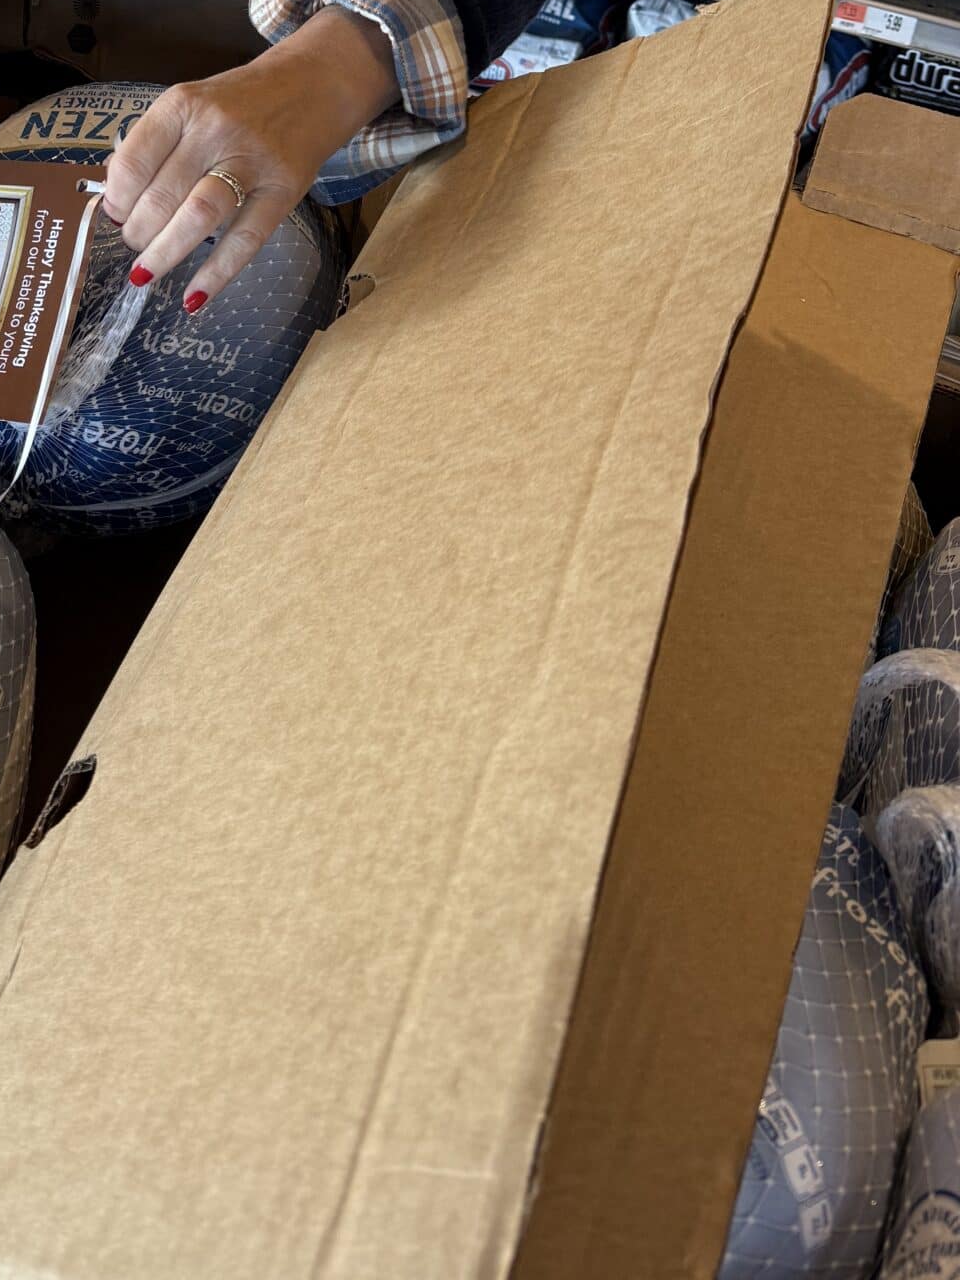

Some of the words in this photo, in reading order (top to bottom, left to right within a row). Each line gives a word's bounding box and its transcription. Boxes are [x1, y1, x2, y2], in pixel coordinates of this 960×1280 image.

[49, 96, 125, 111] TURKEY
[31, 209, 49, 244] from
[41, 219, 65, 268] Happy
[26, 246, 40, 271] our
[15, 274, 35, 311] table
[10, 313, 25, 329] to
[12, 270, 54, 369] Thanksgiving
[143, 326, 242, 378] frozen
[138, 381, 186, 408] frozen
[82, 419, 168, 466] froze
